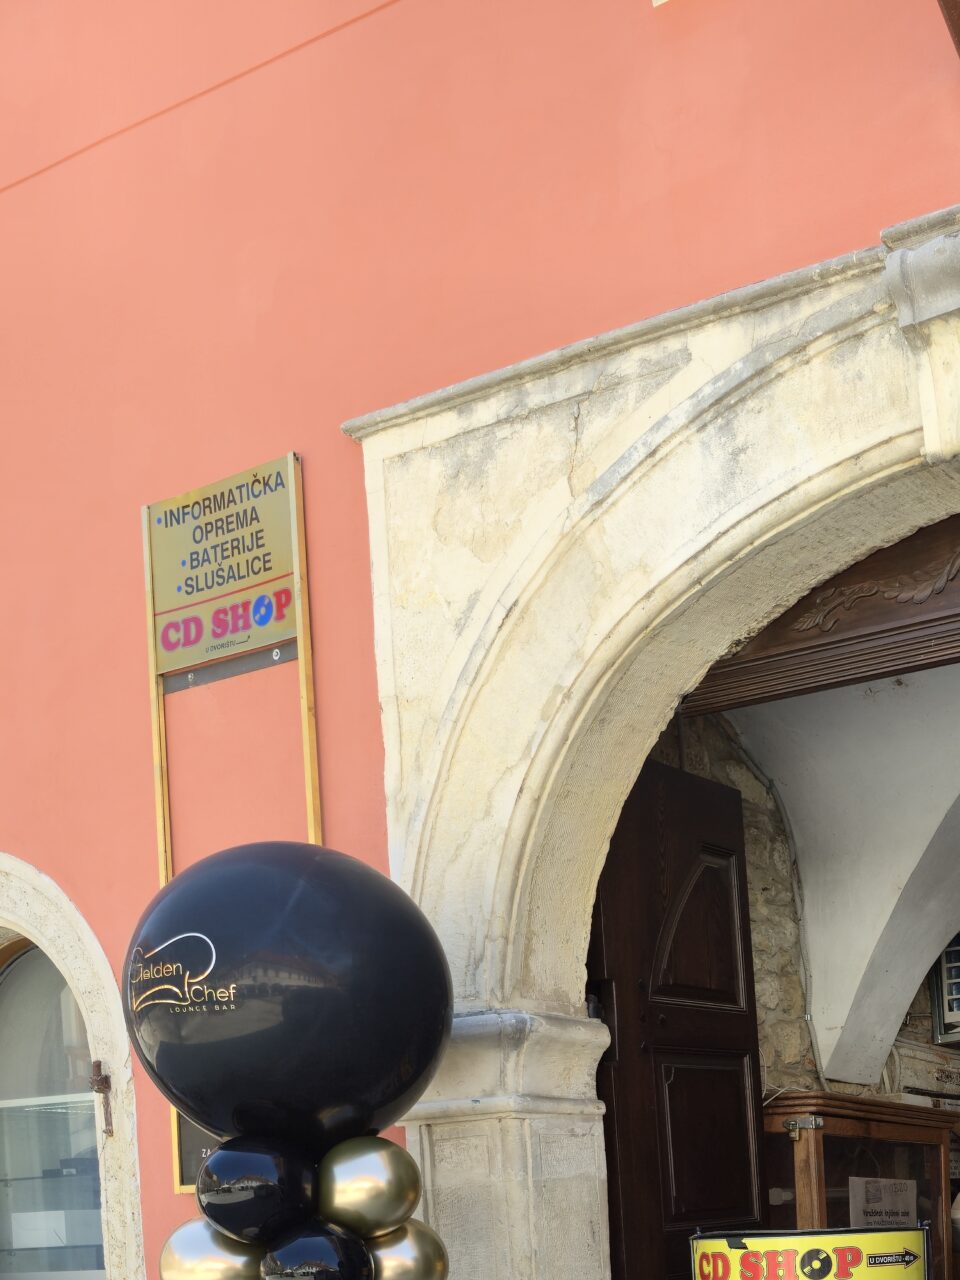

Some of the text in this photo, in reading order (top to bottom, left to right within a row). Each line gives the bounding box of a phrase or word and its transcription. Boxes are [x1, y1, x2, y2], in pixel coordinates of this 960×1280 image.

[164, 471, 286, 528] INFORMATIČKA
[193, 505, 260, 545] OPREMA
[190, 529, 266, 570] BATERIJE
[184, 552, 273, 596] SLUŠALICE
[161, 587, 293, 652] CD SHOP
[169, 1004, 236, 1014] LOUNGE BAR
